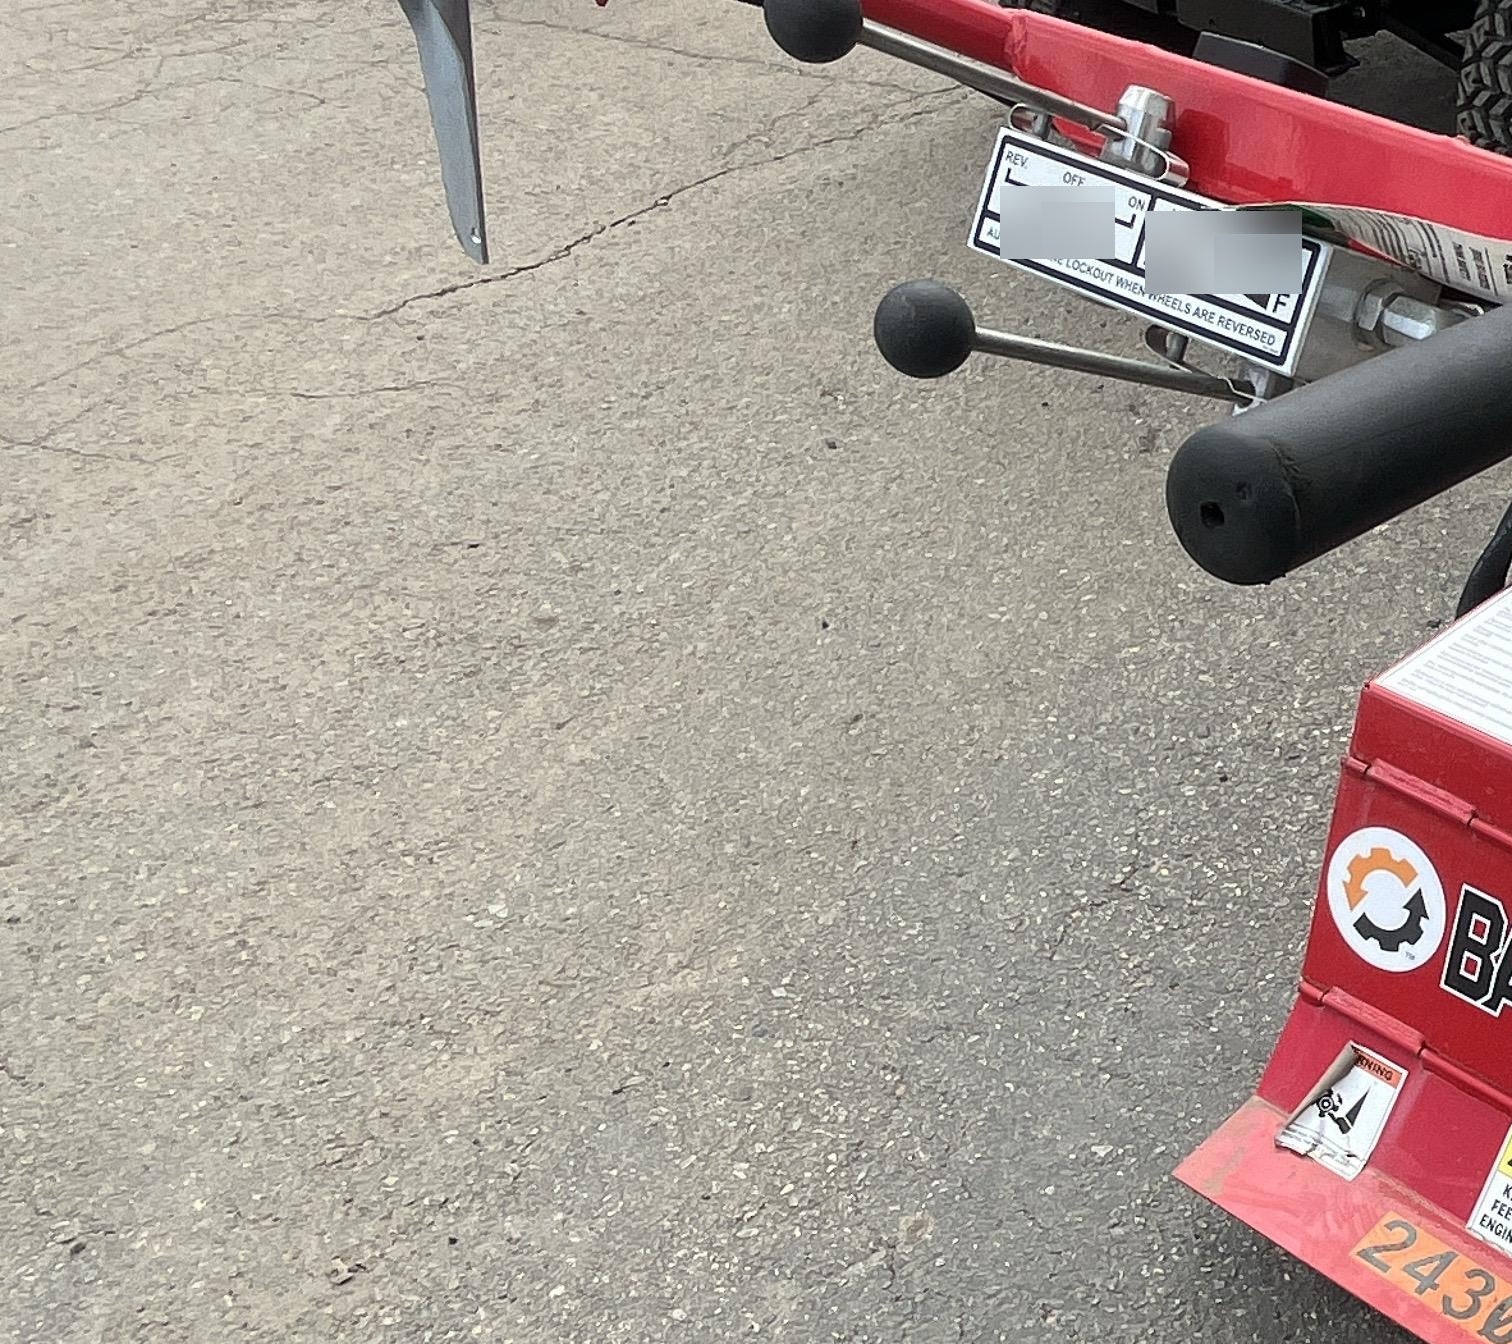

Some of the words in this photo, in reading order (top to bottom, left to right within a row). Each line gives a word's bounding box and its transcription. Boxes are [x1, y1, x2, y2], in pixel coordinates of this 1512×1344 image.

[1127, 195, 1146, 212] ON
[1066, 258, 1114, 284] LOCKOUT
[1115, 275, 1146, 296] WHEN
[1192, 306, 1216, 324] ARE
[1217, 316, 1276, 346] REVERSED
